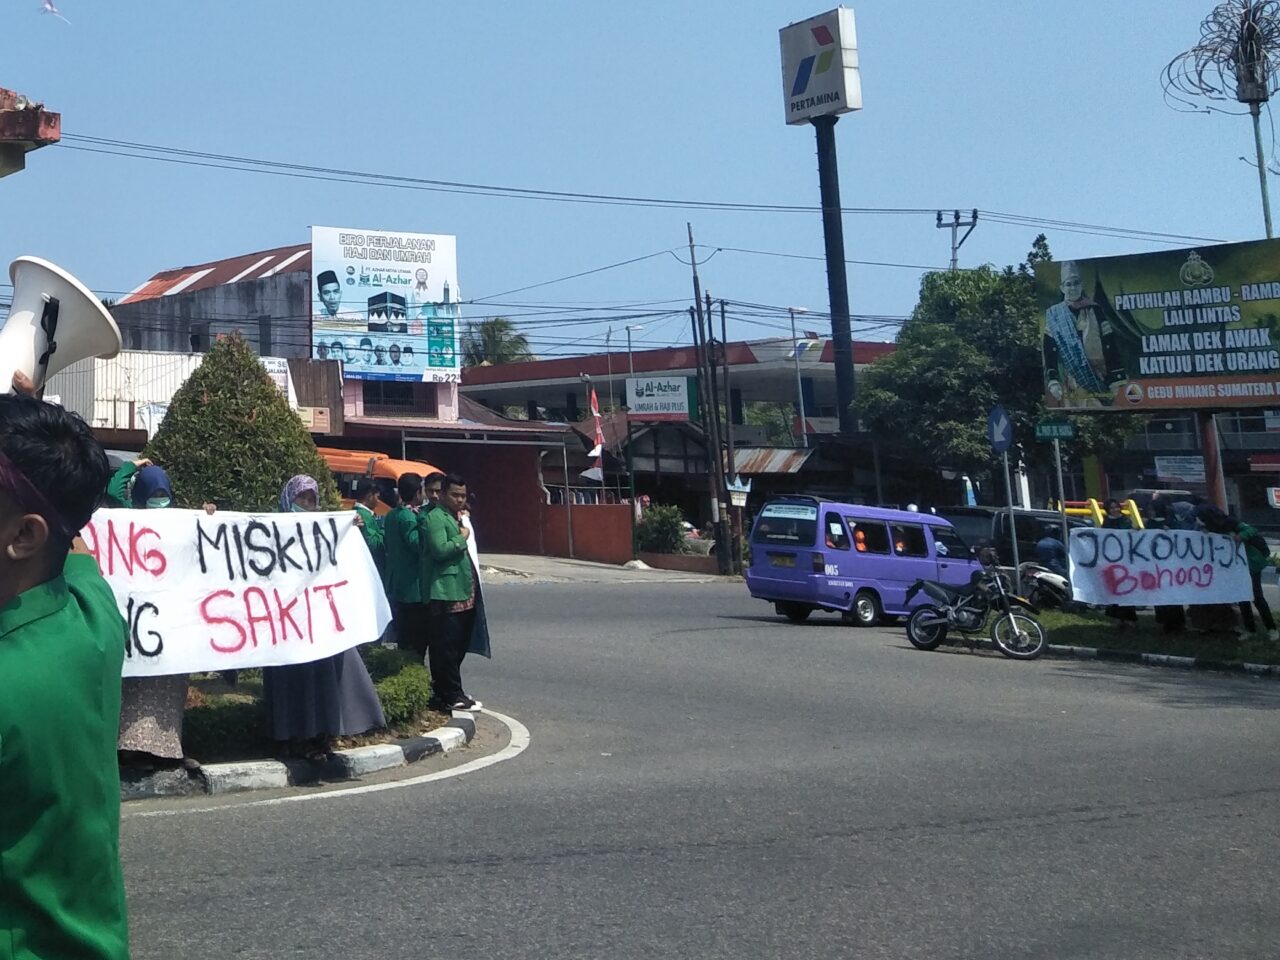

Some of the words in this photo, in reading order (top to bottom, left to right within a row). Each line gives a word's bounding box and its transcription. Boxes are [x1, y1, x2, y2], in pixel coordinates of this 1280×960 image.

[790, 91, 840, 113] PERTAMINA
[339, 233, 365, 247] BIRO
[366, 235, 435, 251] PERJALANAN
[344, 246, 367, 260] HAJI
[369, 248, 392, 261] DAN
[393, 250, 431, 263] UMRAH
[372, 273, 412, 285] Al-Azhar
[1115, 291, 1181, 310] PATUHILAH
[1183, 287, 1231, 306] RAMBU
[1241, 282, 1280, 300] RAMB
[1163, 309, 1194, 326] LALU
[1196, 306, 1241, 324] LINTAS
[1142, 333, 1191, 353] LAMAK
[1193, 331, 1222, 350] DEK
[1225, 328, 1271, 348] AWAK
[1139, 355, 1192, 374] KATUJU
[1195, 354, 1224, 372] DEK
[1226, 351, 1280, 370] URANG
[645, 380, 680, 392] Al-Azhar
[1148, 386, 1173, 399] GEBU
[1176, 385, 1215, 398] MINANG
[1218, 383, 1272, 396] SUMATERA
[87, 519, 166, 577] ANG
[196, 516, 340, 580] MISKIN
[200, 578, 349, 653] SAKIT
